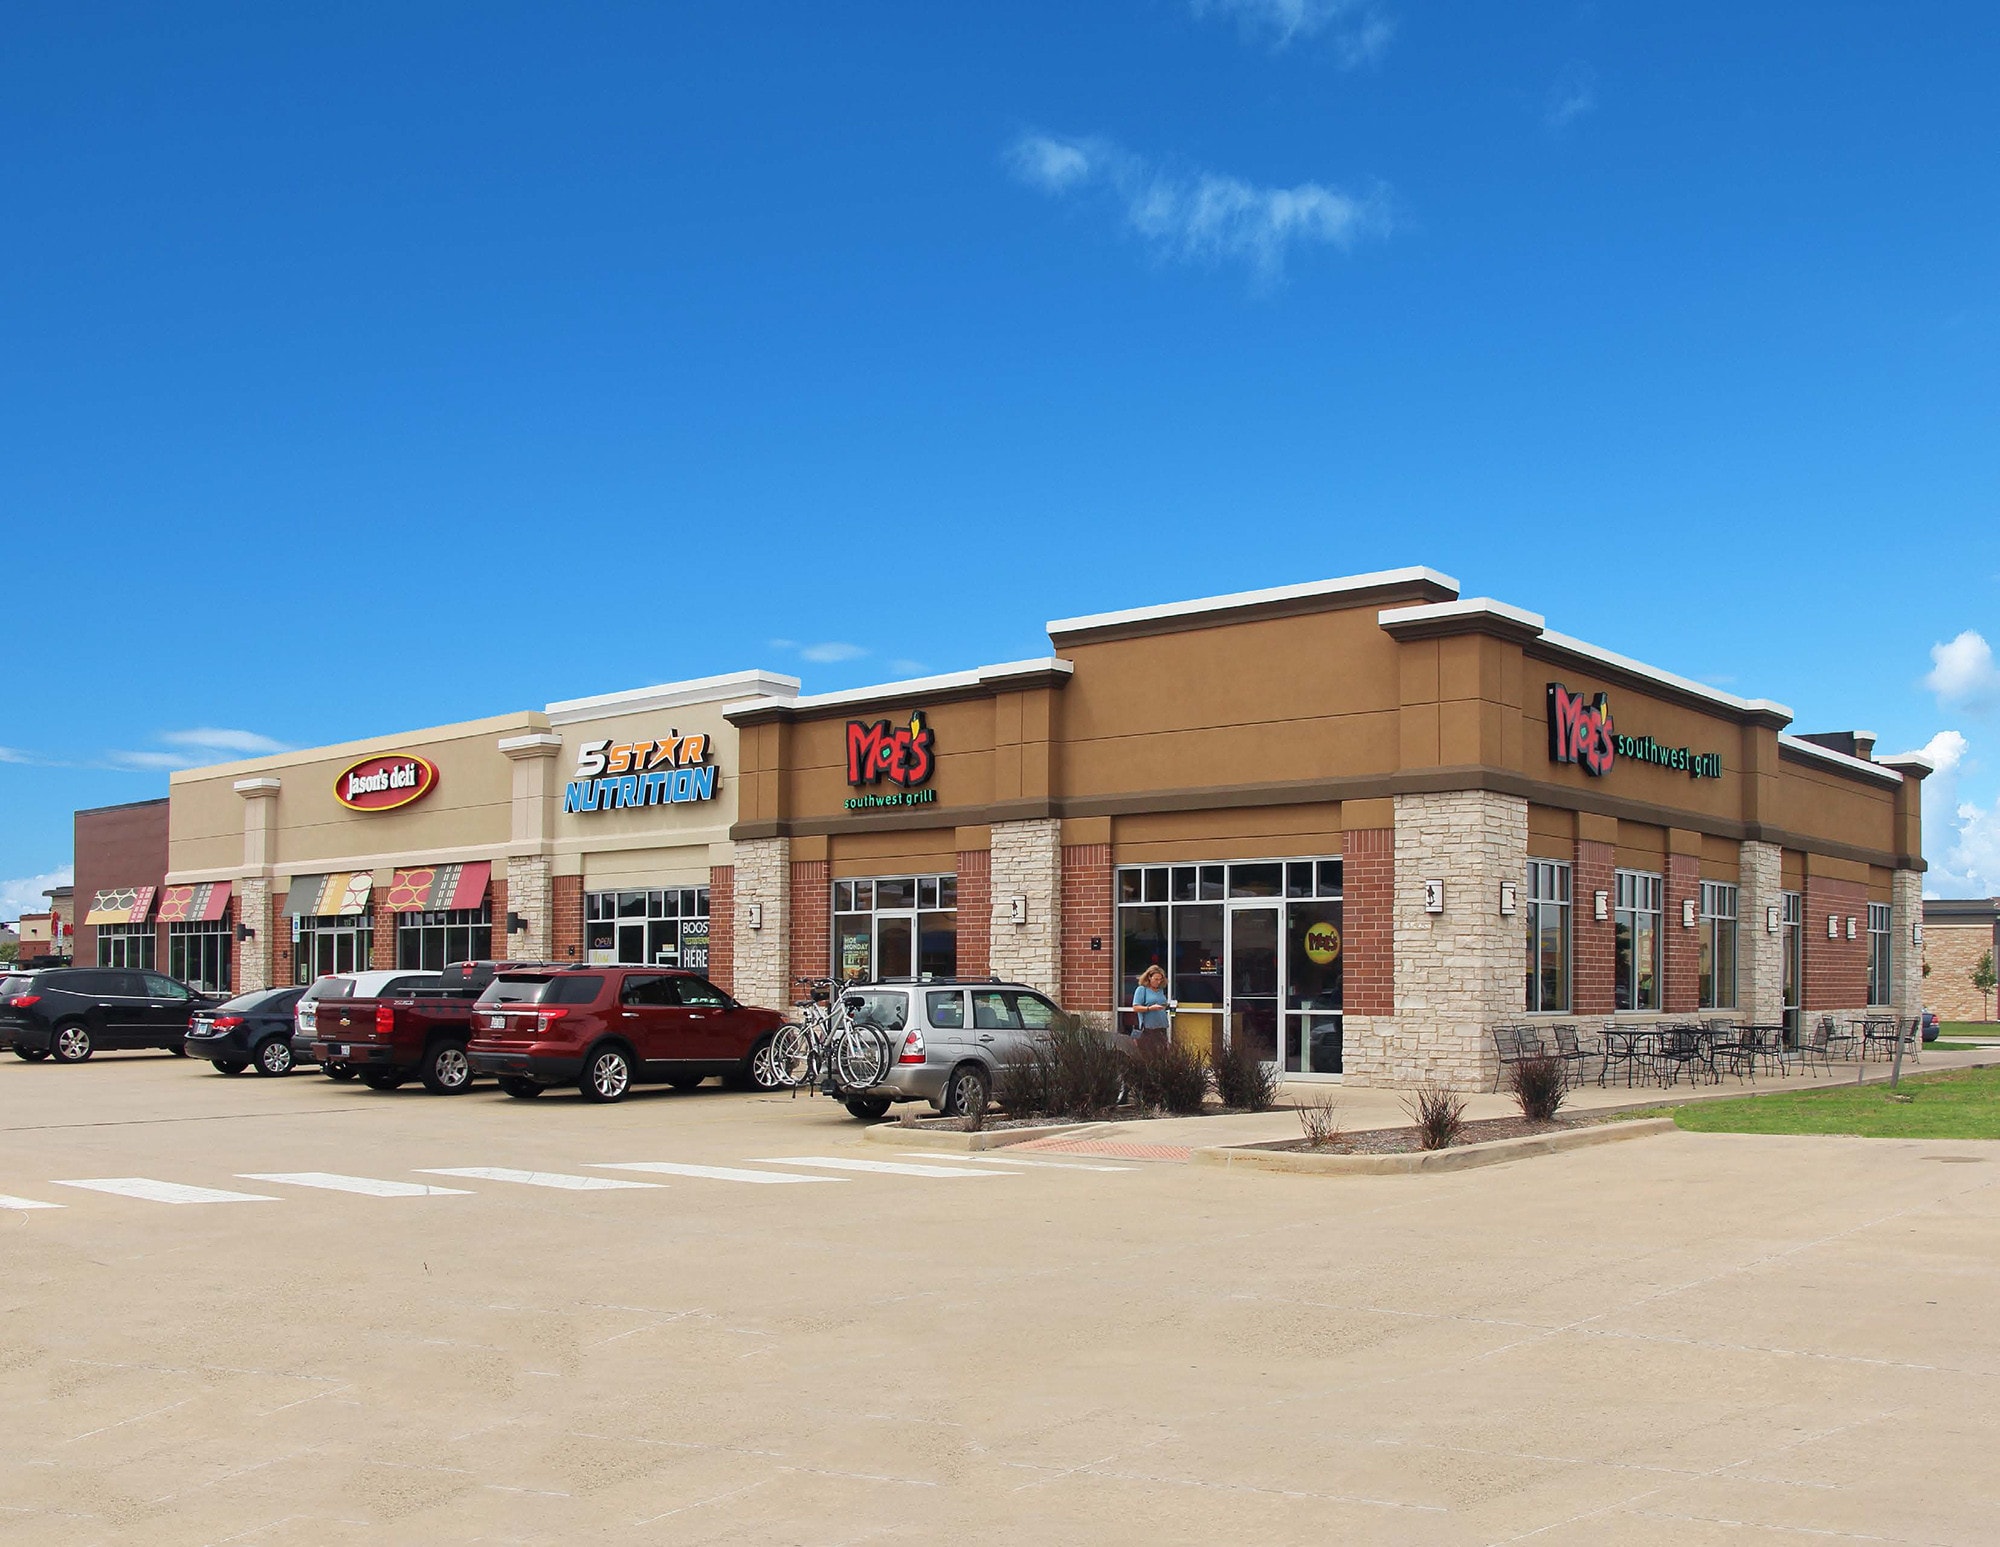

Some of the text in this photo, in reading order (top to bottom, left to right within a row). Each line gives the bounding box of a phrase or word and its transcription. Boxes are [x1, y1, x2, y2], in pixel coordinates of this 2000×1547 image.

[1618, 734, 1690, 771] southwest
[1695, 753, 1722, 779] grill
[346, 763, 416, 801] Jason's deli
[563, 765, 716, 814] NUTRITION
[844, 789, 933, 809] southwest grill
[683, 921, 709, 934] BOOS
[683, 949, 708, 968] HERE
